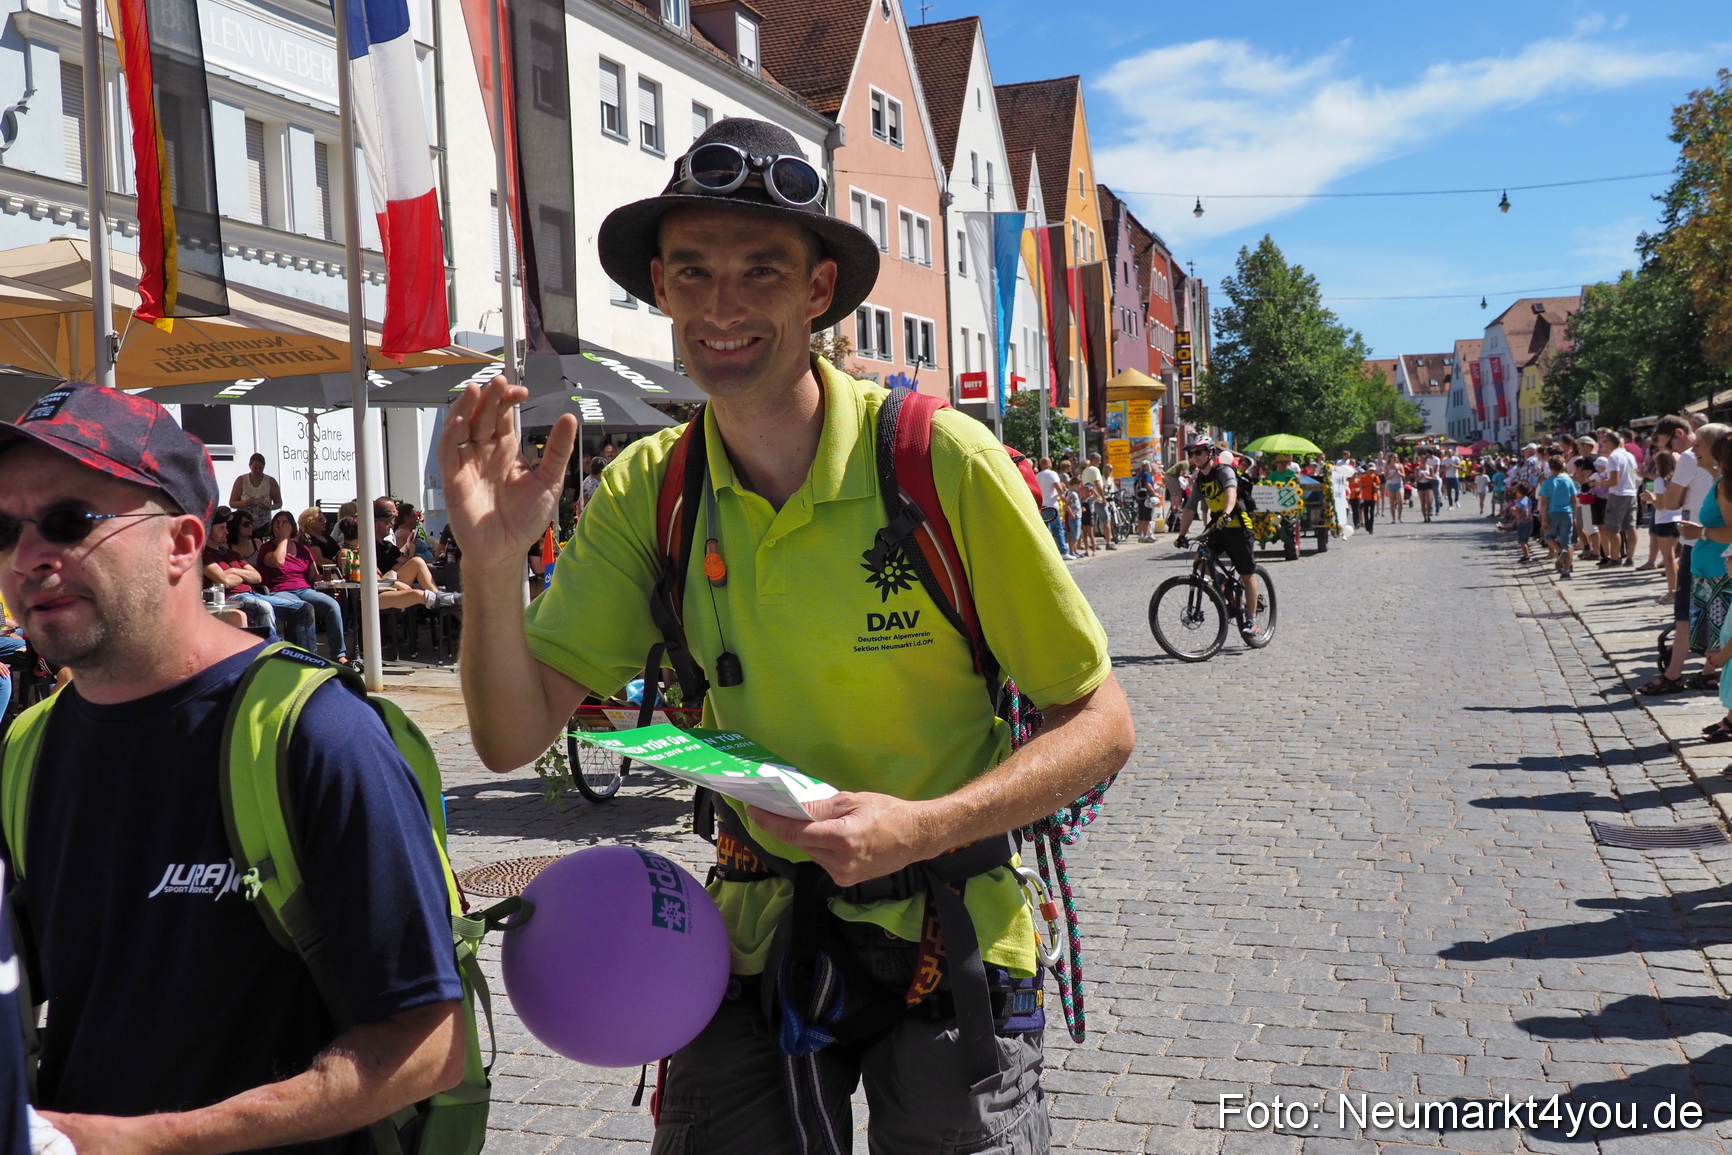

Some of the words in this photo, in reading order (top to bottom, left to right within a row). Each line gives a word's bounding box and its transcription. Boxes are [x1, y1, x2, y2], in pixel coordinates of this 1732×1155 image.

[257, 30, 336, 88] WEBER
[1177, 332, 1192, 408] HOTEL
[219, 378, 265, 396] no
[964, 380, 983, 388] WITT
[282, 445, 309, 464] Bang
[292, 466, 302, 481] in
[304, 466, 351, 481] Neumarkt
[867, 610, 920, 632] DAV
[857, 635, 891, 643] Deutscher
[893, 631, 931, 641] Alpenverein
[881, 641, 912, 650] Neumarkt
[281, 649, 326, 666] BURTON
[148, 863, 228, 899] JURA
